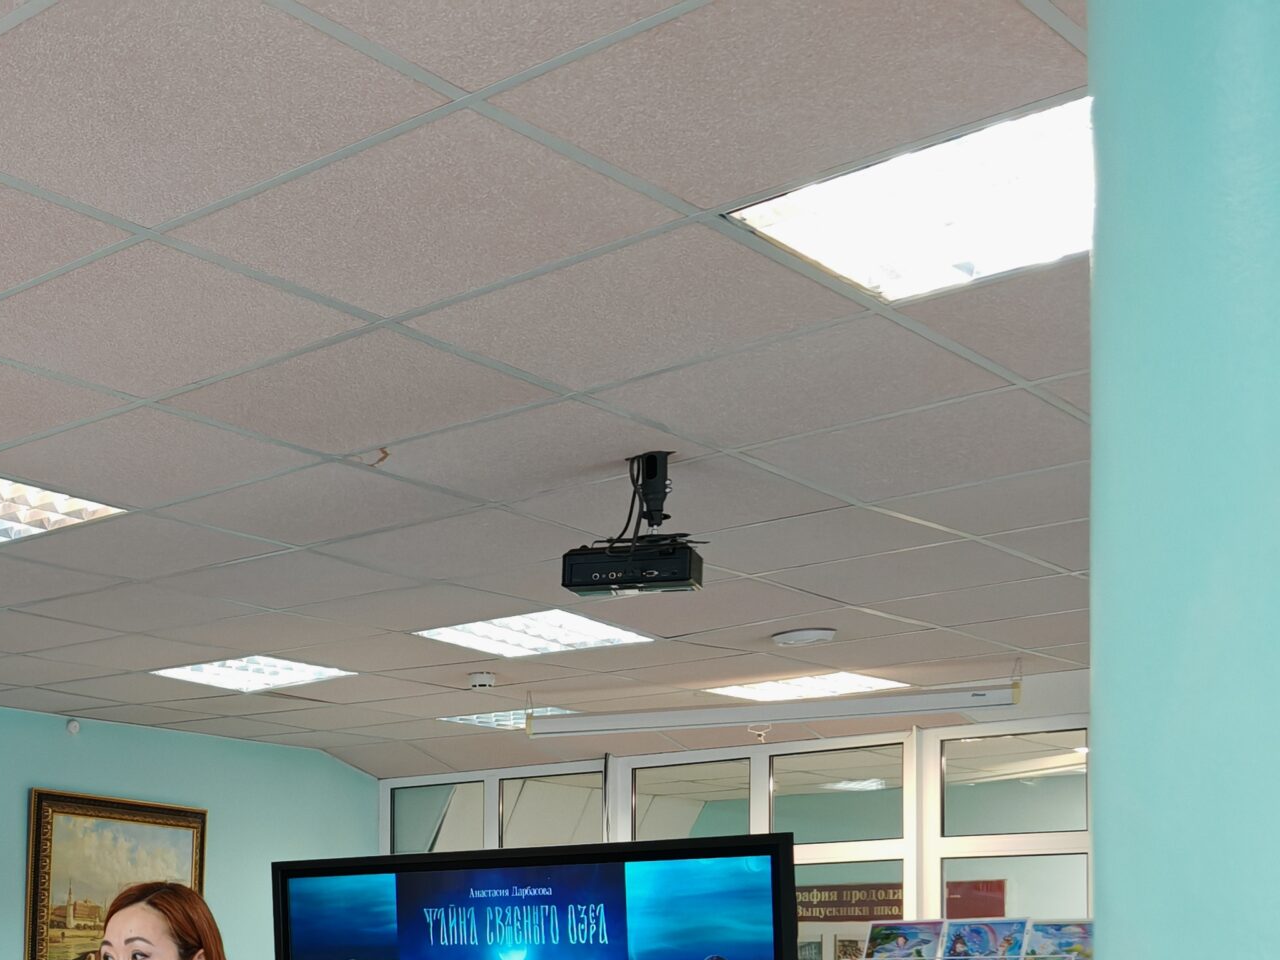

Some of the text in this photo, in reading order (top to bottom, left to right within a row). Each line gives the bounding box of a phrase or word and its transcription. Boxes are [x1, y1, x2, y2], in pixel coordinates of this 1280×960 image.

[469, 886, 553, 899] Анастасия Дарбасова
[423, 904, 479, 946] ТАЙНА
[568, 903, 609, 945] ОЗЕРА
